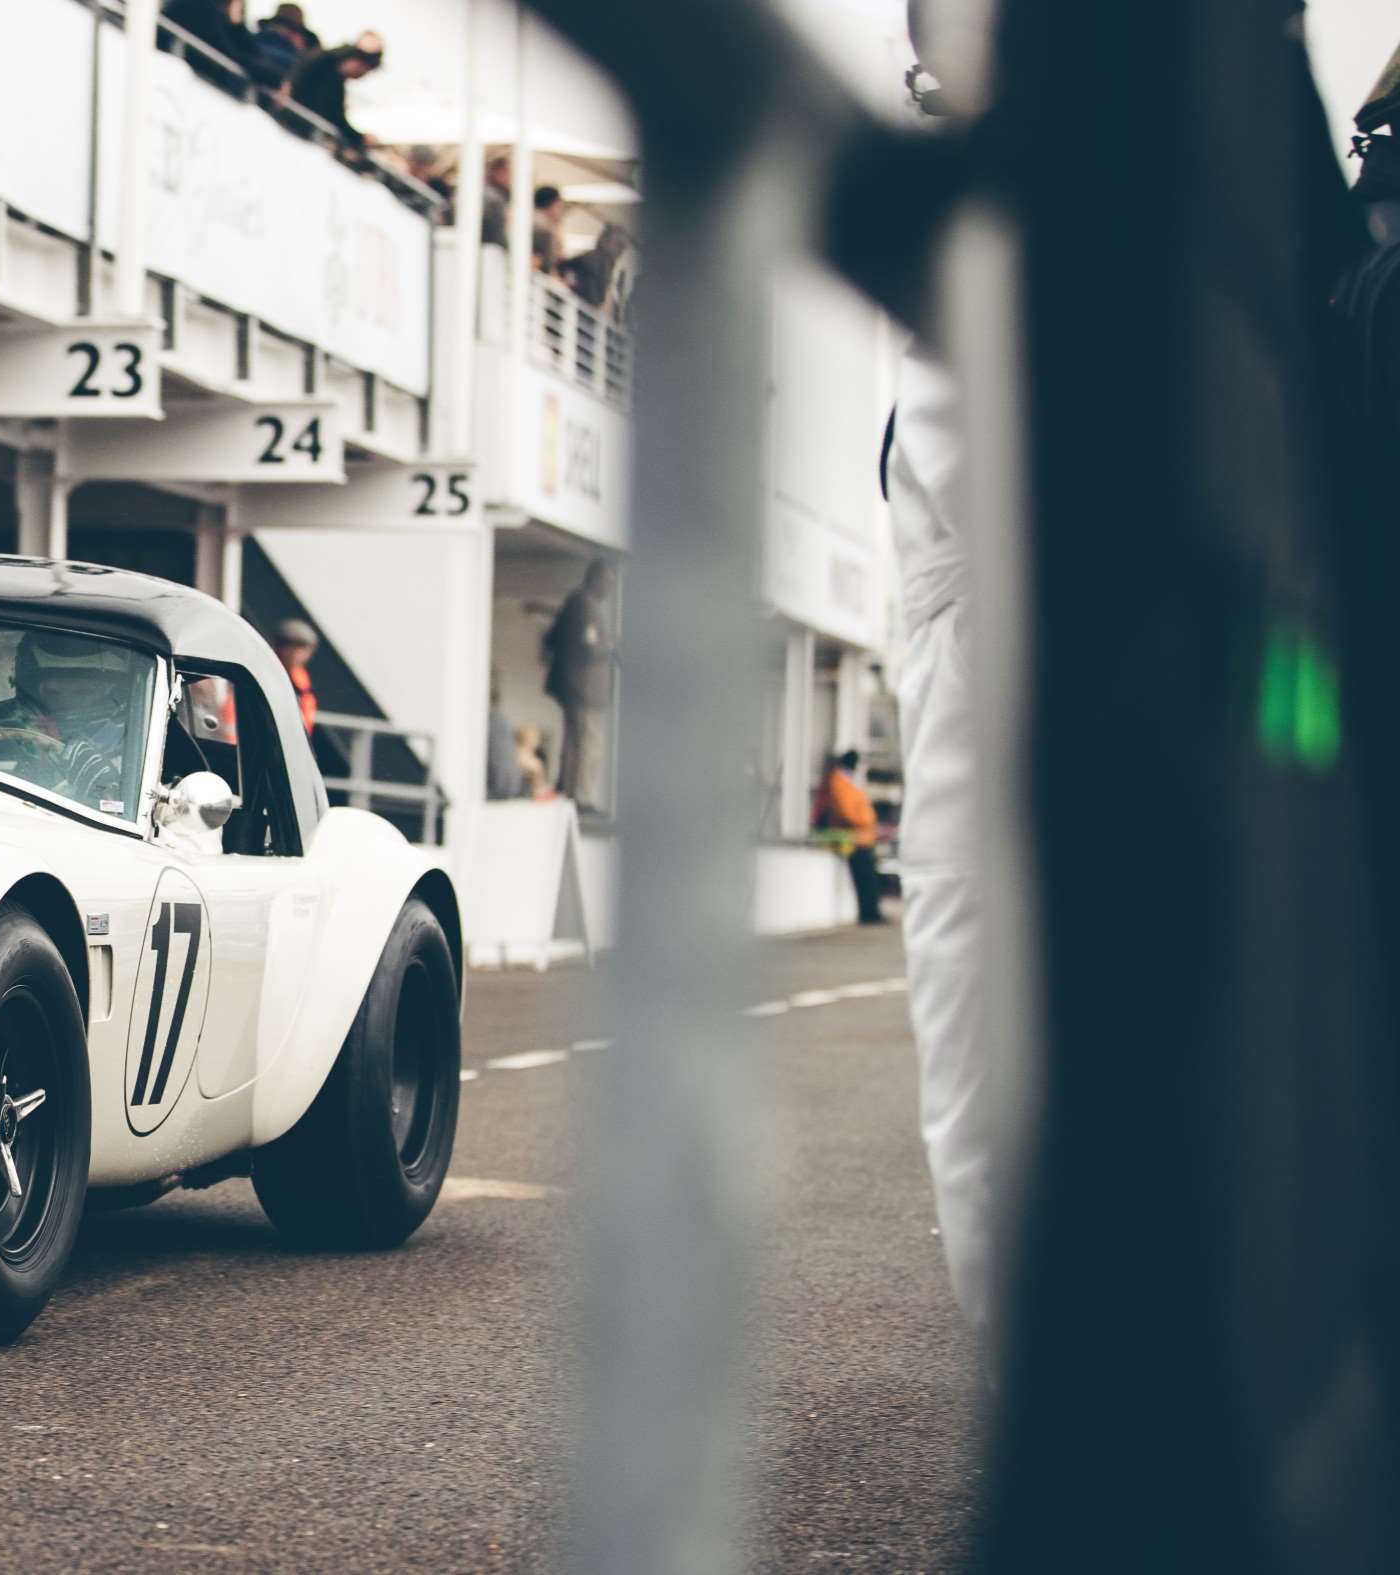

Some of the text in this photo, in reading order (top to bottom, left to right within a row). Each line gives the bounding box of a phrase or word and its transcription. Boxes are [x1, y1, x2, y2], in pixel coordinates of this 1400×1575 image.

[66, 341, 143, 398] 23
[255, 415, 323, 464] 24
[411, 472, 470, 516] 25
[130, 902, 202, 1107] 17
